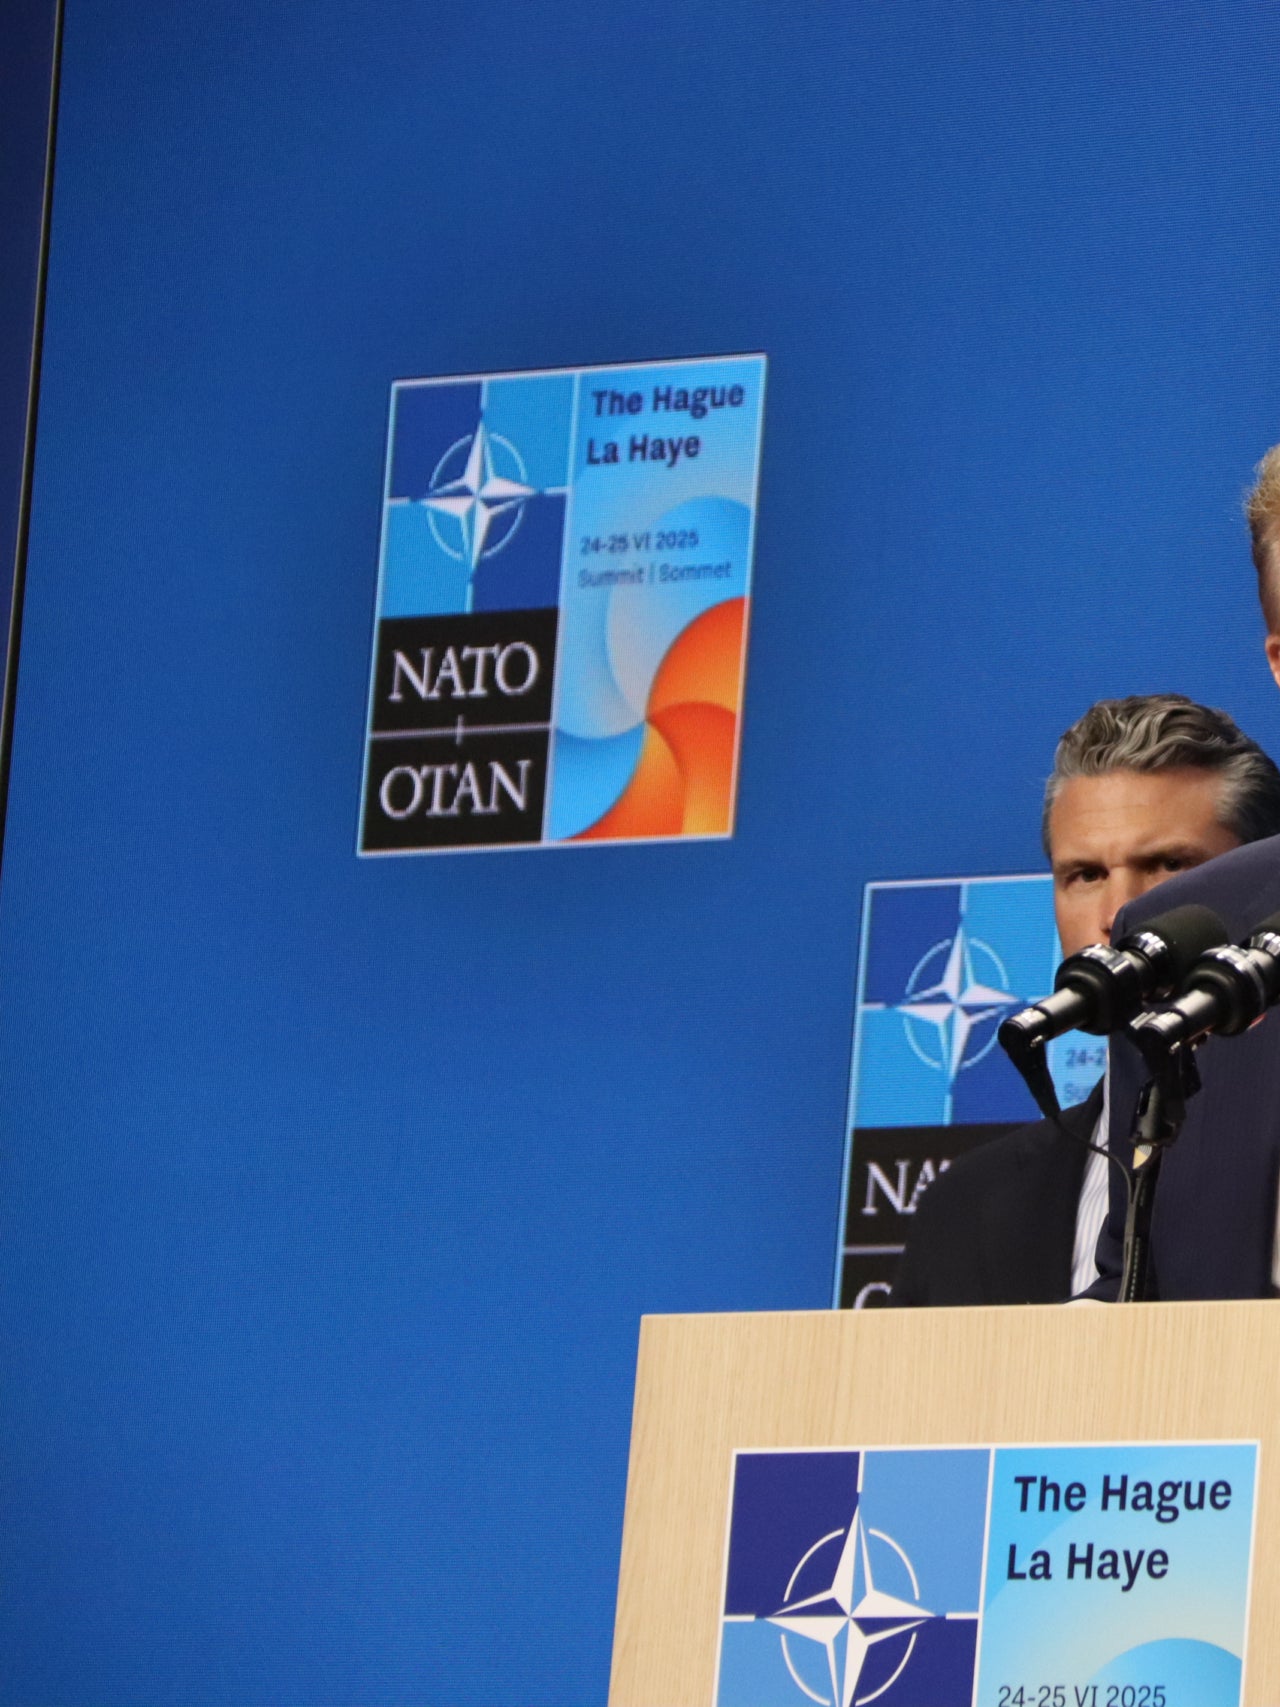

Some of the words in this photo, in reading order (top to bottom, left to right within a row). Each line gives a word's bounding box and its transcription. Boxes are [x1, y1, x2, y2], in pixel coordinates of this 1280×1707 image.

[592, 389, 644, 417] The
[652, 383, 745, 419] Hague
[586, 437, 619, 465] La
[629, 432, 701, 468] Haye
[580, 533, 629, 555] 24-25
[633, 531, 650, 553] VI
[655, 528, 699, 550] 2025
[578, 566, 645, 588] Summit
[659, 561, 732, 582] Sommet
[388, 641, 540, 700] NATO
[379, 759, 531, 820] OTAN
[1065, 1046, 1108, 1068] 24-2
[861, 1158, 953, 1216] NA
[1013, 1475, 1088, 1512] The
[1100, 1475, 1233, 1523] Hague
[1006, 1543, 1053, 1581] La
[1066, 1543, 1170, 1593] Haye
[998, 1685, 1066, 1707] 24-25
[1074, 1685, 1099, 1707] VI
[1106, 1685, 1166, 1707] 2025
